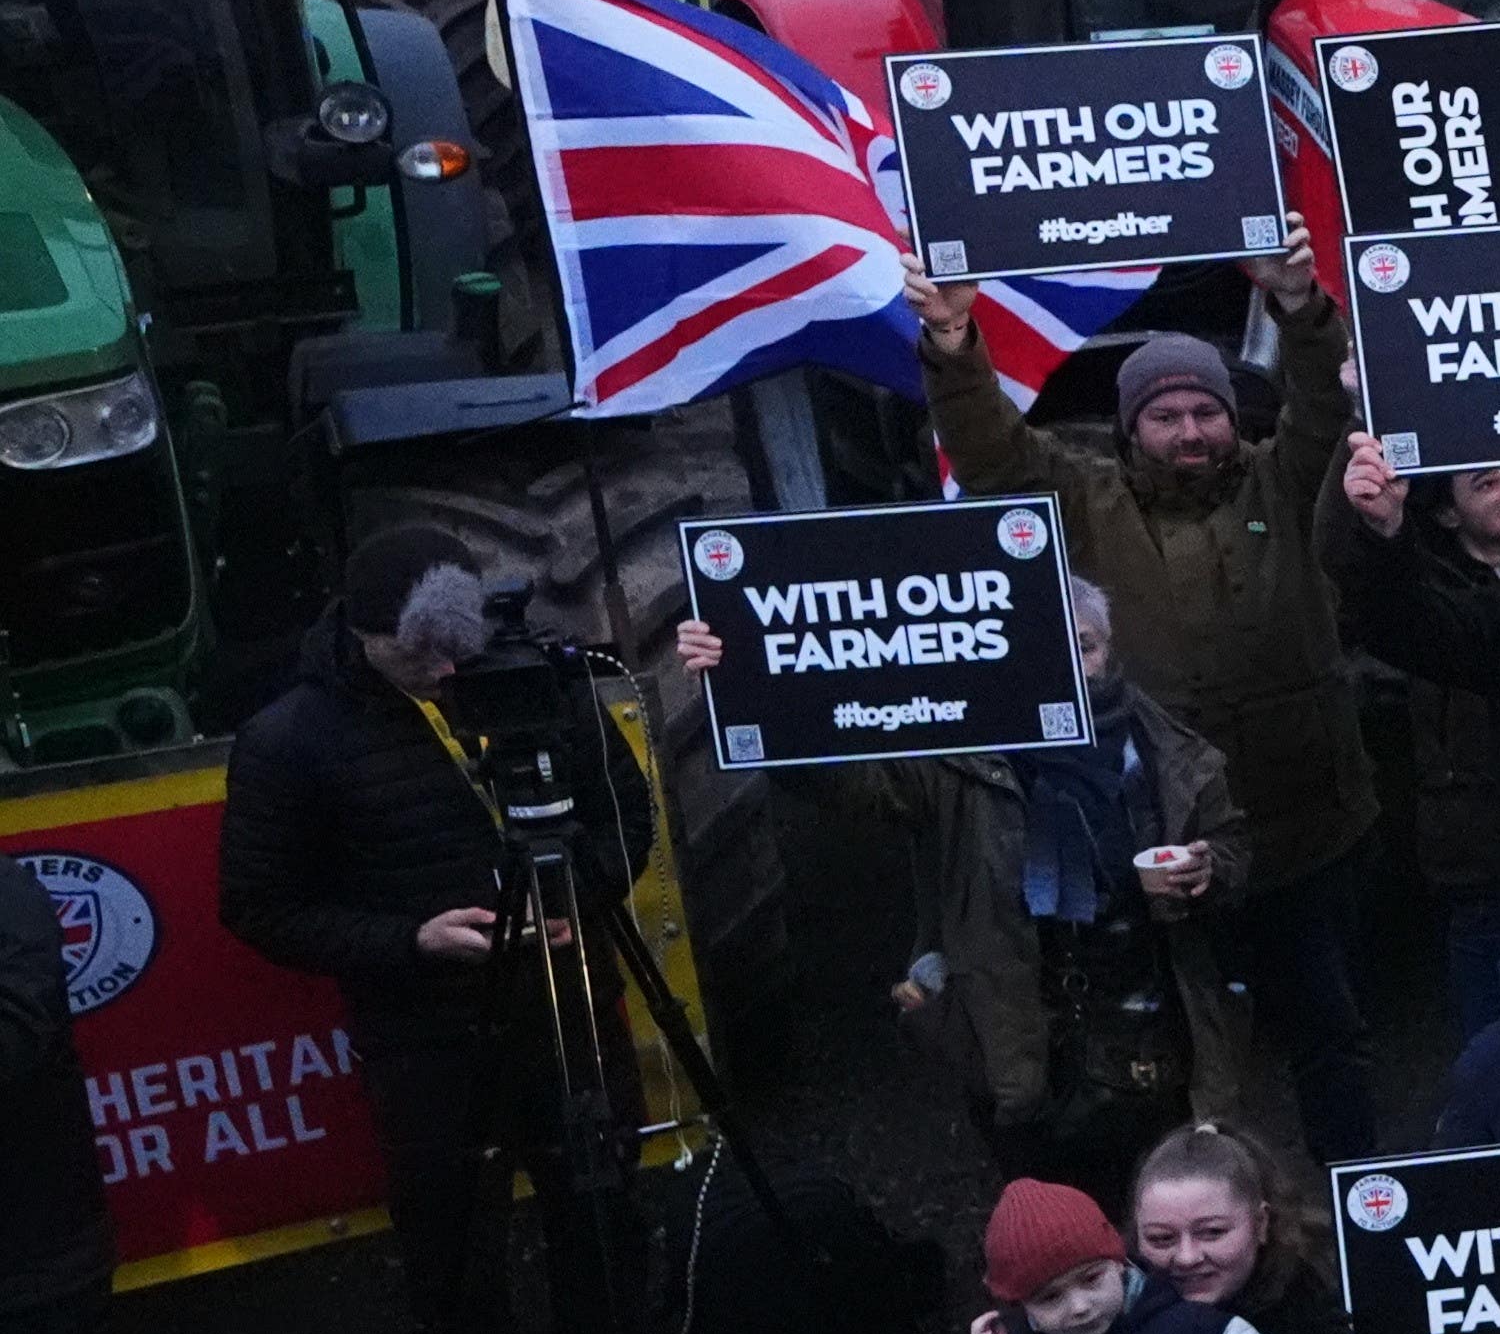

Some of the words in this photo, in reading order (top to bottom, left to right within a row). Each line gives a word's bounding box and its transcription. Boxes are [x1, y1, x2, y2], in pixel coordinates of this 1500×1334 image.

[951, 106, 1096, 150] WITH
[1105, 99, 1219, 140] OUR
[971, 142, 1214, 194] FARMERS
[1039, 212, 1172, 244] #together
[744, 578, 887, 626] WITH
[897, 570, 1013, 615] OUR
[764, 619, 1009, 674] FARMERS
[834, 697, 967, 731] #together
[205, 1095, 327, 1162] ALL
